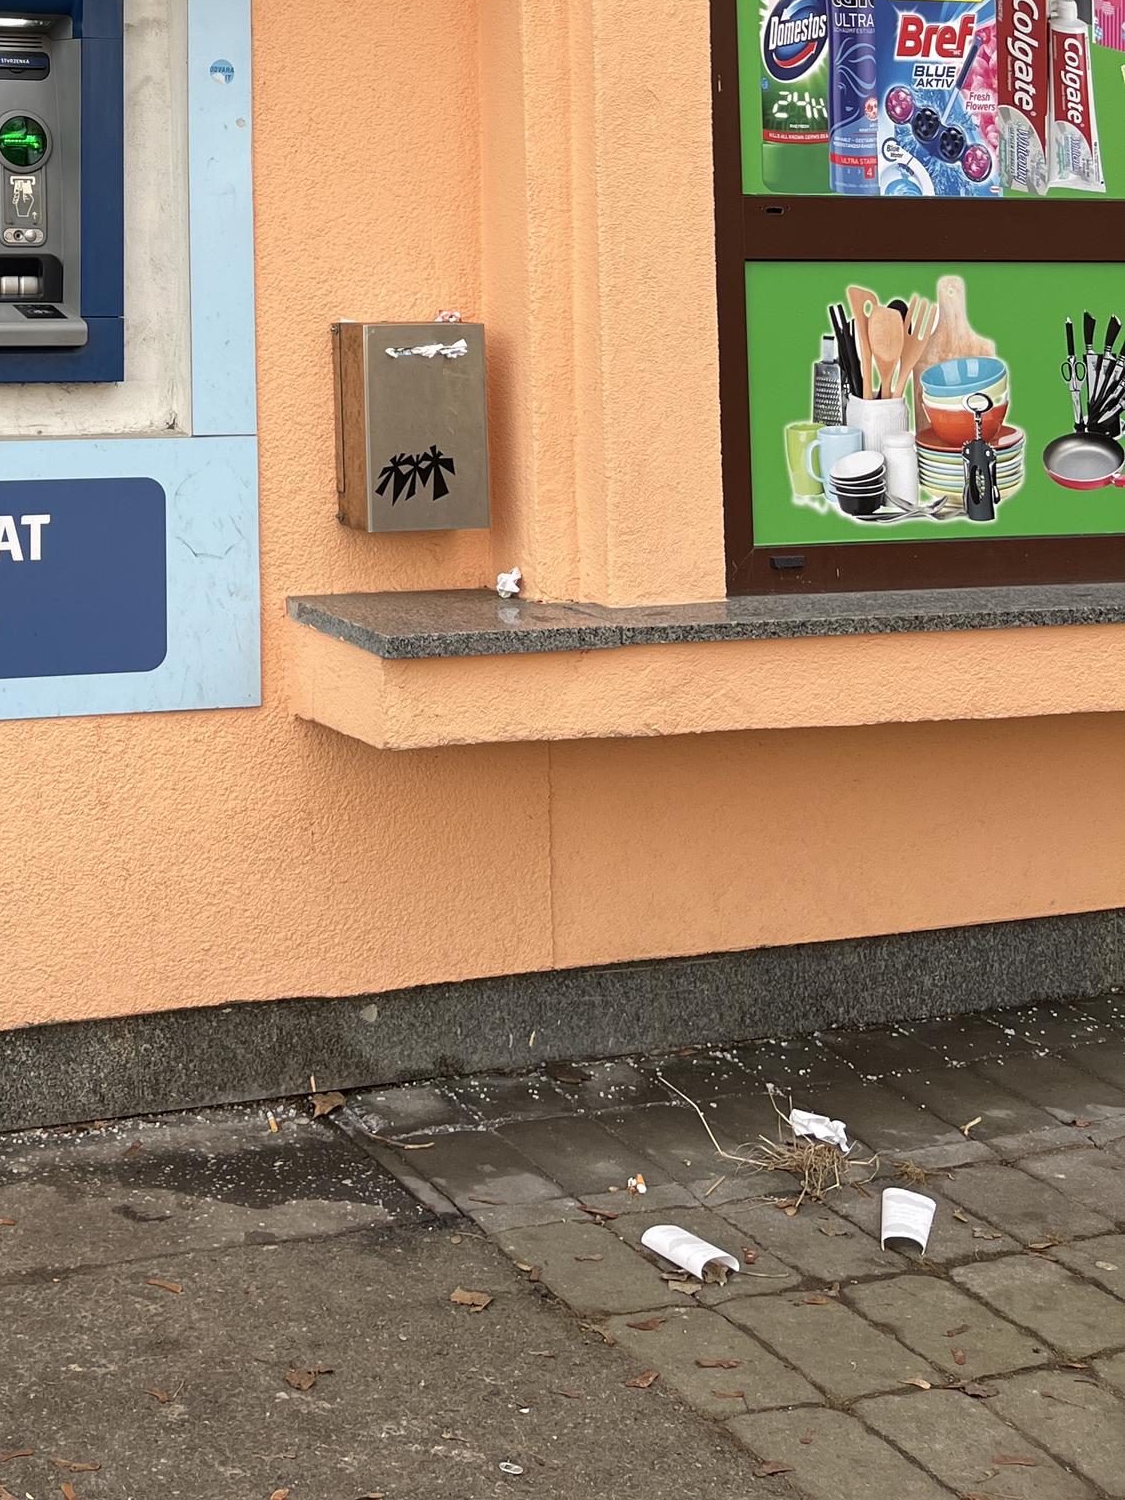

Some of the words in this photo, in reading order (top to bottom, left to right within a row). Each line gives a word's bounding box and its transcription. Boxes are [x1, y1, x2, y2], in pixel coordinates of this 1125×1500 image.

[835, 12, 874, 28] ULTRA
[769, 13, 827, 50] Domestos
[896, 14, 976, 58] Bref
[914, 65, 956, 78] BLUE
[915, 78, 955, 88] AKTIV
[1060, 37, 1084, 124] Colgate
[969, 92, 991, 102] Fresh
[965, 101, 996, 111] Flowers
[1013, 128, 1031, 185] Whitening
[866, 167, 873, 177] 4
